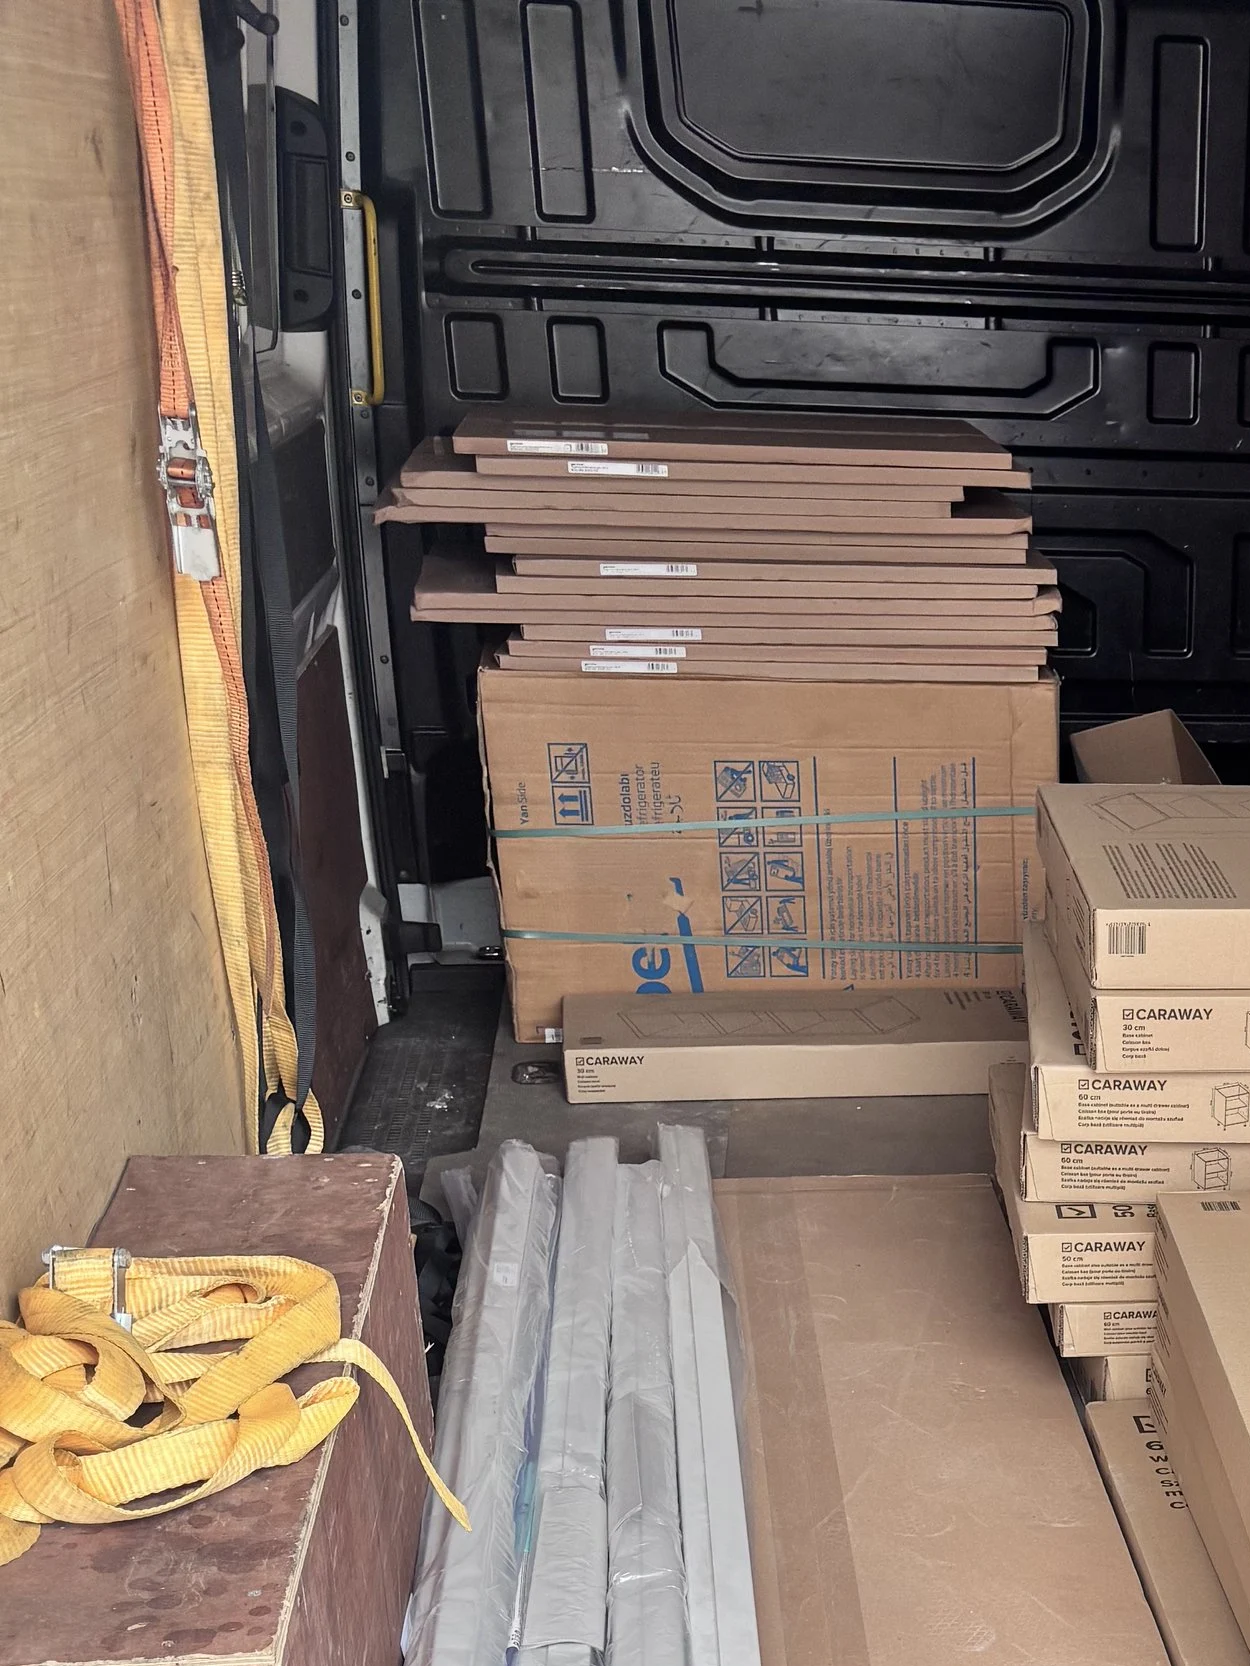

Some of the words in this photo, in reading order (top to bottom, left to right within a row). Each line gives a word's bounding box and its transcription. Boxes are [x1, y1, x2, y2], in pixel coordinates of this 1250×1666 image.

[516, 782, 528, 804] Side
[619, 773, 633, 826] uzdolabı
[518, 805, 529, 825] Yan
[1136, 1009, 1213, 1020] CARAWAY
[586, 1056, 645, 1066] CARAWAY
[1091, 1079, 1167, 1091] CARAWAY
[1074, 1143, 1148, 1155] CARAWAY
[1074, 1241, 1146, 1252] CARAWAY
[1113, 1310, 1158, 1320] CARAWA
